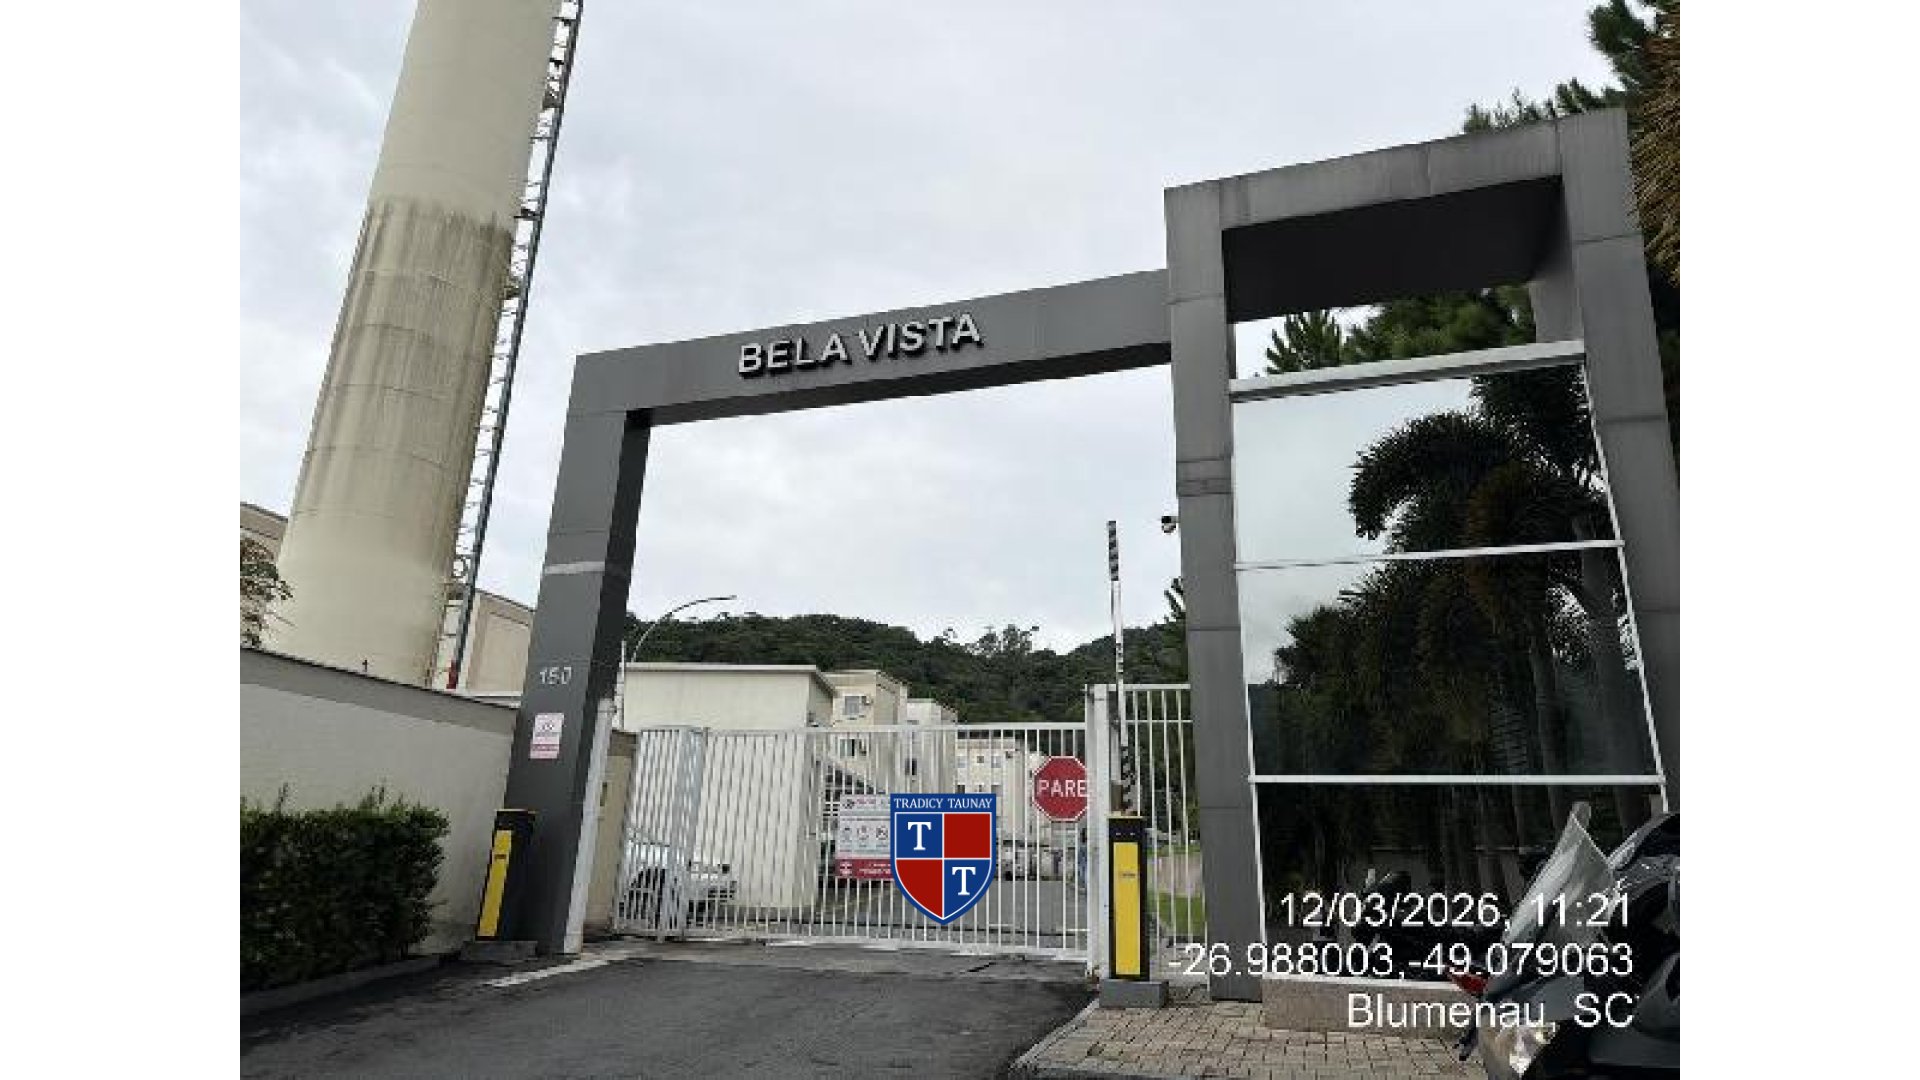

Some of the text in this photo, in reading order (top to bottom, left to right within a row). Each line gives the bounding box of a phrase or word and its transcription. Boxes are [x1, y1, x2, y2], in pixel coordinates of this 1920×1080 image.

[738, 312, 983, 376] BELA VISTA
[540, 667, 571, 685] 150
[1037, 779, 1089, 797] PARE
